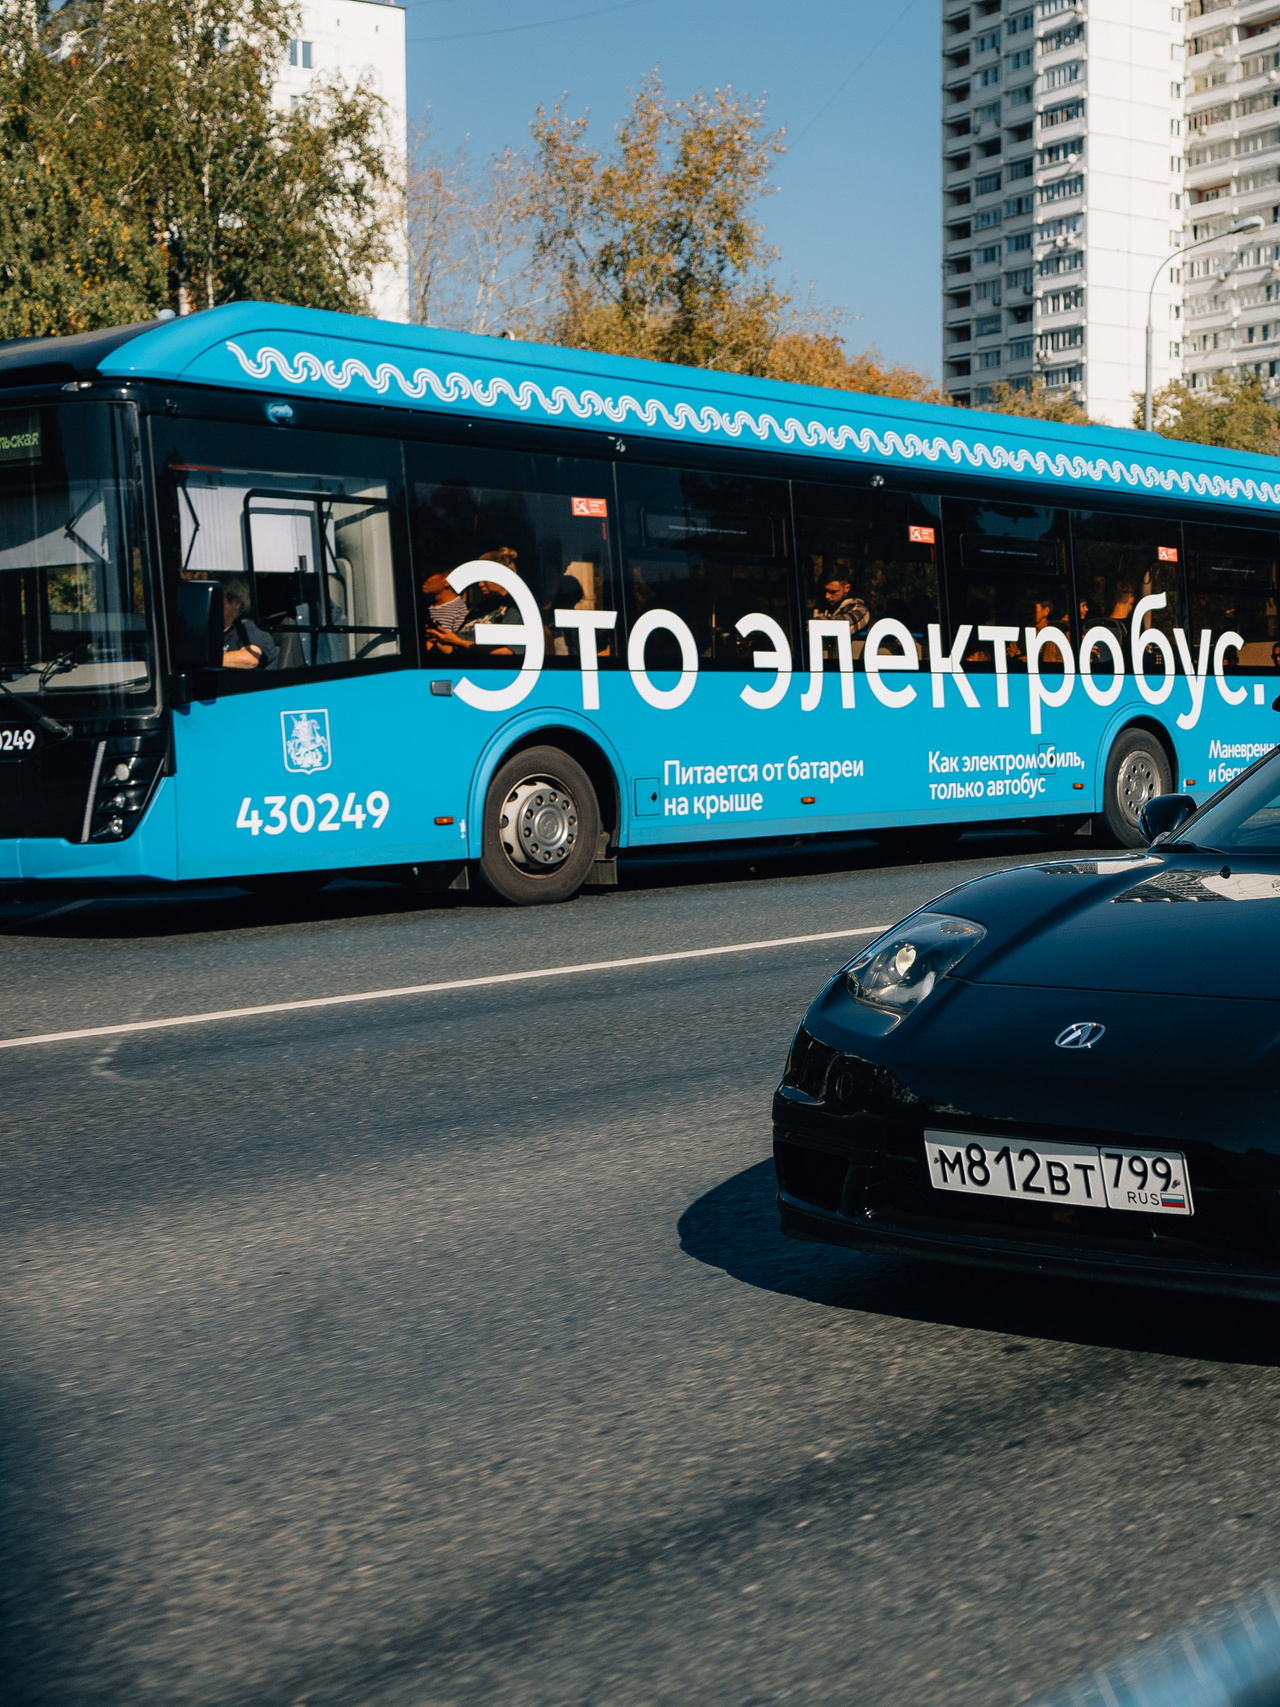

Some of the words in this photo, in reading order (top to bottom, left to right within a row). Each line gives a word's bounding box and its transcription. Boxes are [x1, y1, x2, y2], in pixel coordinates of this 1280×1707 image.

[446, 560, 699, 712] Это
[735, 592, 1265, 734] электробус.
[0, 729, 36, 751] 249
[664, 759, 759, 786] Питается
[762, 762, 784, 782] от
[787, 755, 864, 784] батареи
[928, 750, 959, 773] Как
[961, 745, 1085, 775] электромобиль,
[929, 781, 984, 800] только
[987, 772, 1046, 799] автобус
[1208, 768, 1216, 783] и
[236, 790, 390, 836] 430249
[664, 796, 689, 816] на
[693, 791, 764, 820] крыше
[938, 1142, 1096, 1199] М812ВТ
[1105, 1152, 1173, 1192] 799
[1127, 1191, 1160, 1206] RUS
